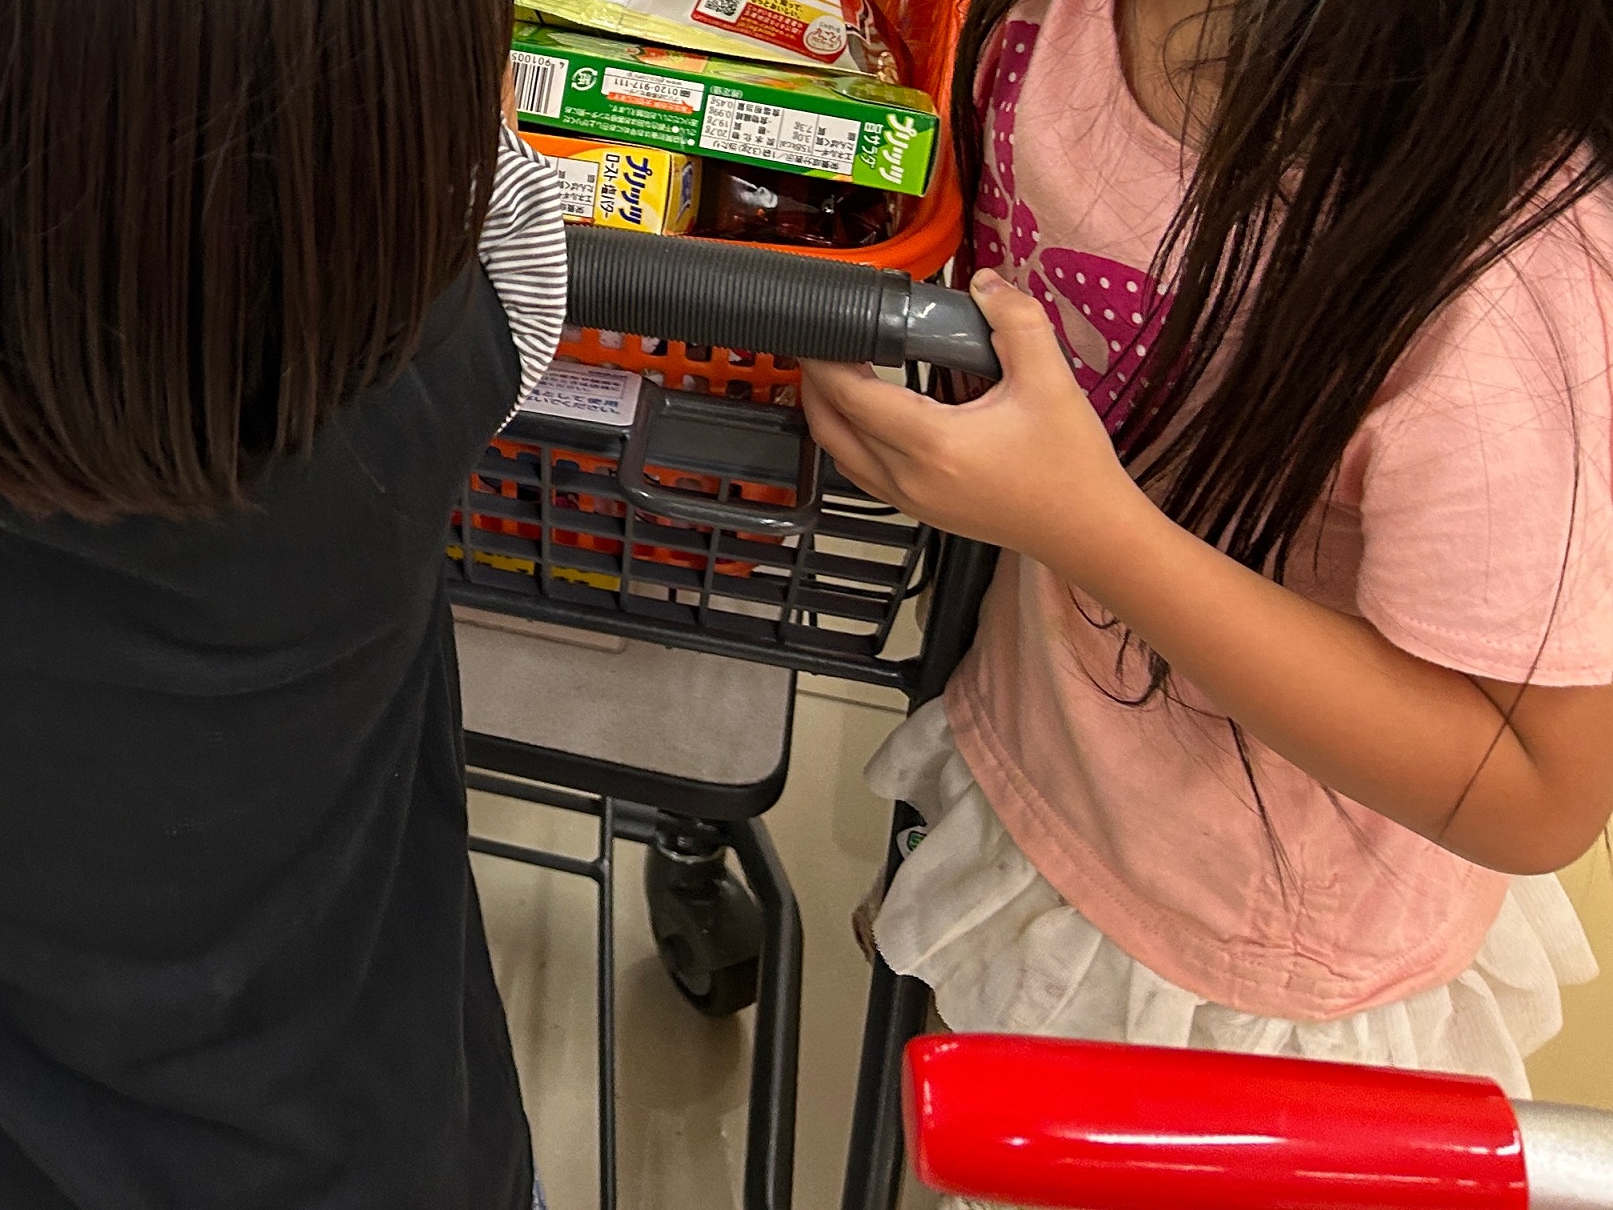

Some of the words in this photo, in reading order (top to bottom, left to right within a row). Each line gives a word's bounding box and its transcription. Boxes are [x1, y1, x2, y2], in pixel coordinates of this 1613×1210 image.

[614, 79, 678, 96] 0120-917-111
[878, 113, 917, 184] プリッツ
[618, 155, 653, 225] プリッツ
